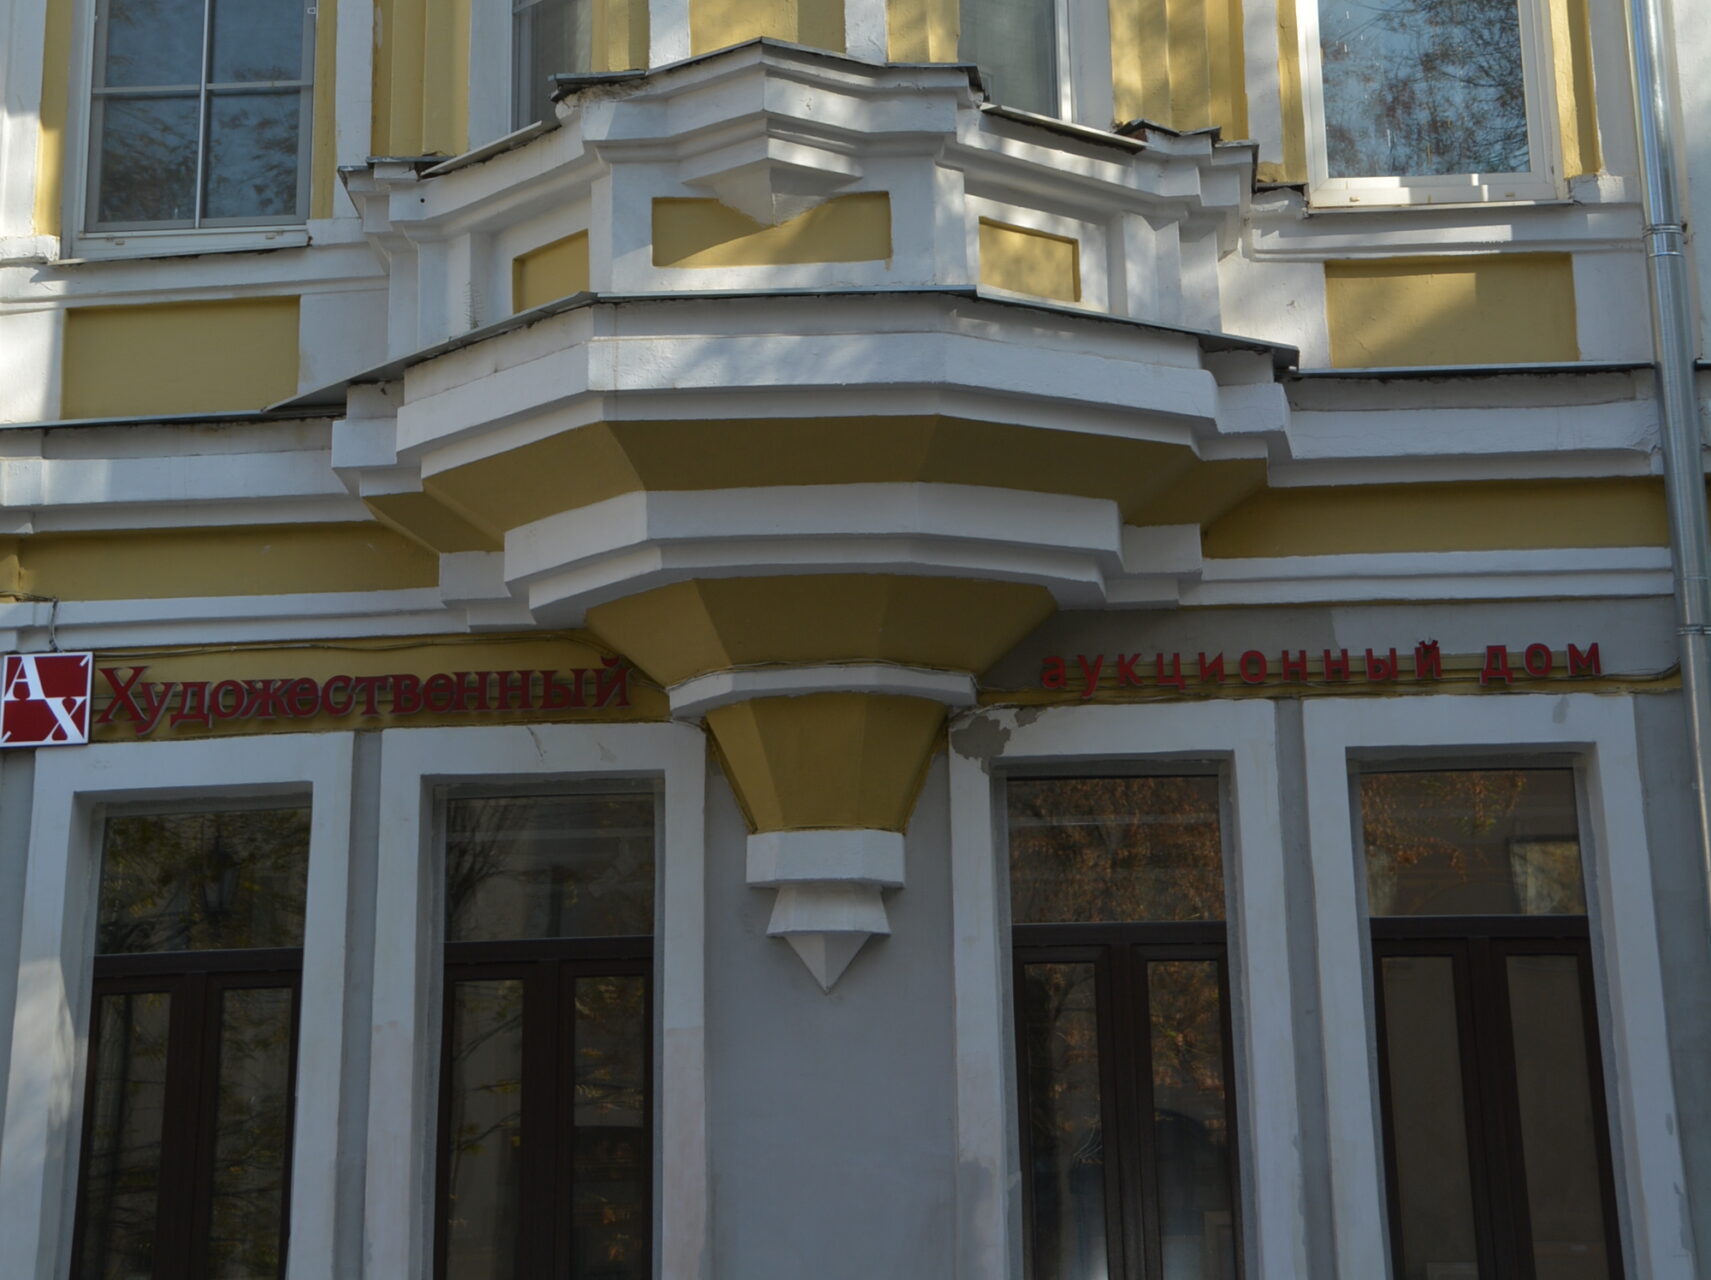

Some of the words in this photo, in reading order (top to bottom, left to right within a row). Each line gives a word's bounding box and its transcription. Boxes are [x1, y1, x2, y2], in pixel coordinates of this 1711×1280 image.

[95, 656, 633, 734] Художественный
[1041, 640, 1442, 699] аукционный
[1480, 642, 1601, 686] дом
